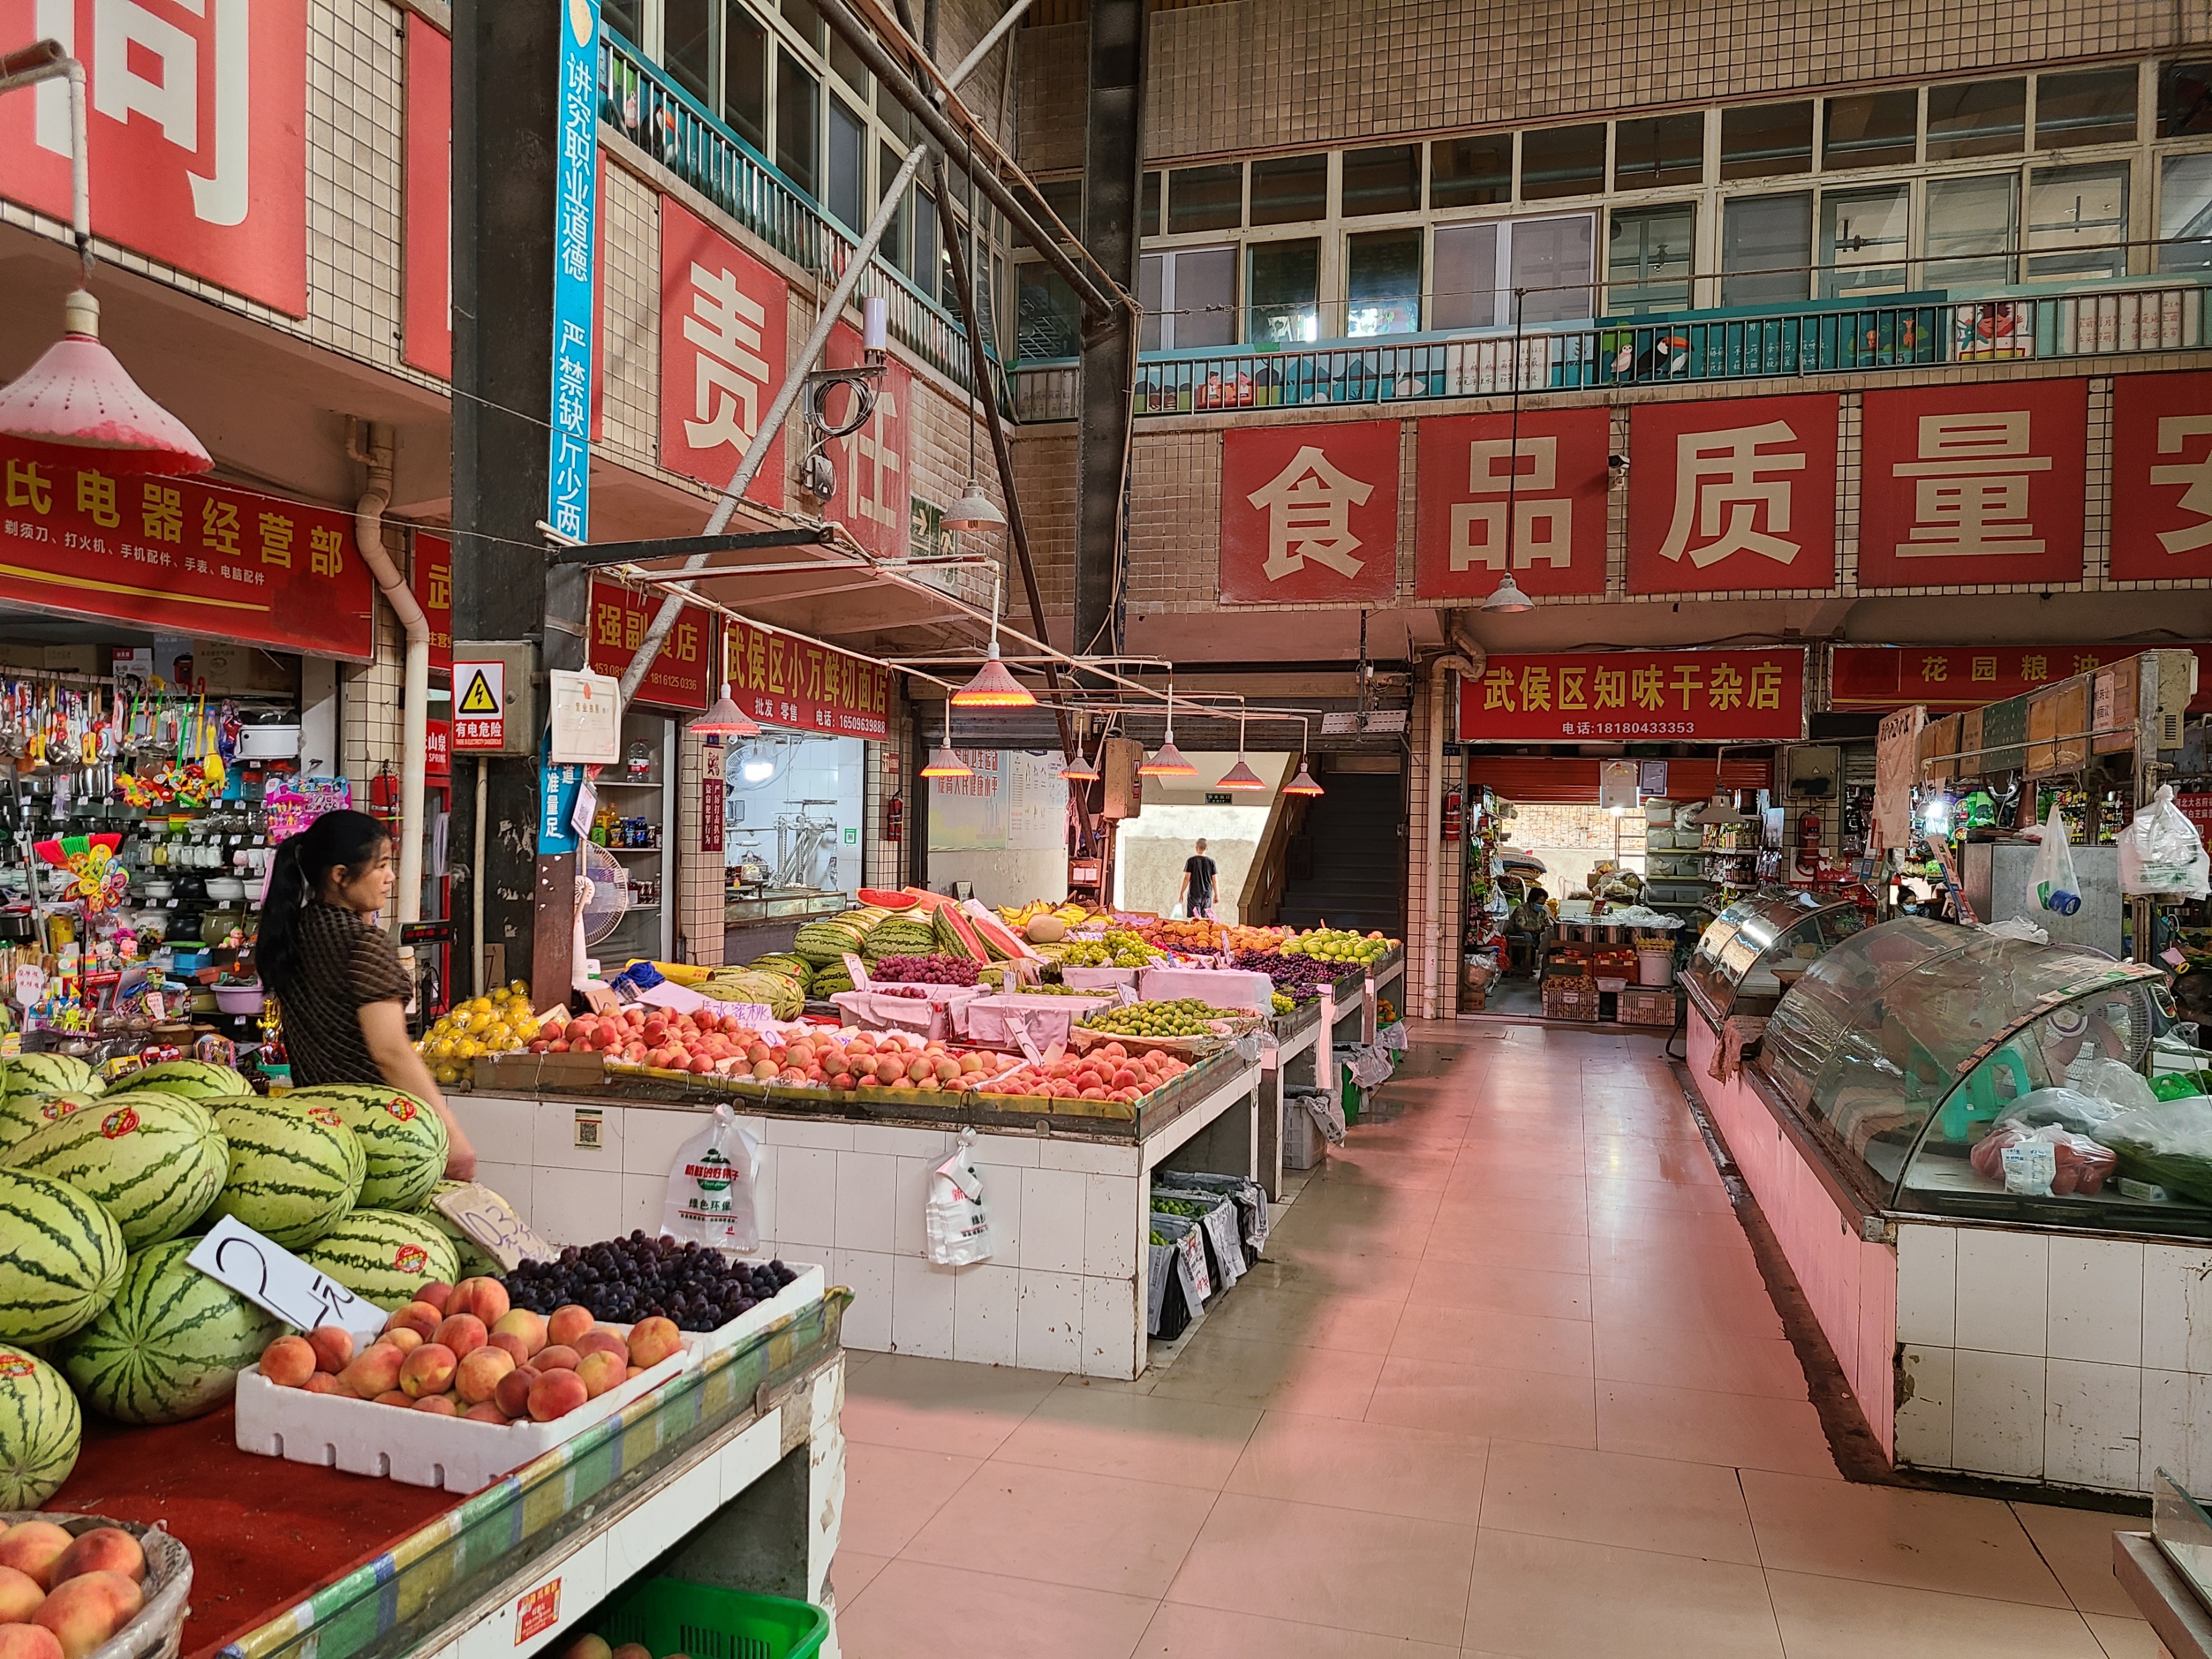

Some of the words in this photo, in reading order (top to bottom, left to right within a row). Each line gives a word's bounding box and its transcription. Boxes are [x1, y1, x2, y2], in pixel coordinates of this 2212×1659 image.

[561, 52, 593, 283] 讲究职业道德
[556, 319, 587, 541] 严禁缺斤少两
[5, 519, 266, 586] 剃须刀、打火机、手机配件、手表、电脑配件
[680, 678, 697, 690] 0336
[727, 624, 887, 715] 武侯区小万鲜切面店
[1483, 661, 1782, 712] 武侯区知味干杂店
[455, 721, 502, 738] 有电危险
[755, 696, 774, 718] 批发
[780, 702, 798, 722] 零售
[839, 715, 886, 734] 16509639888
[684, 1164, 740, 1181] 新鲜的好果子
[689, 1198, 732, 1212] 绿色环保
